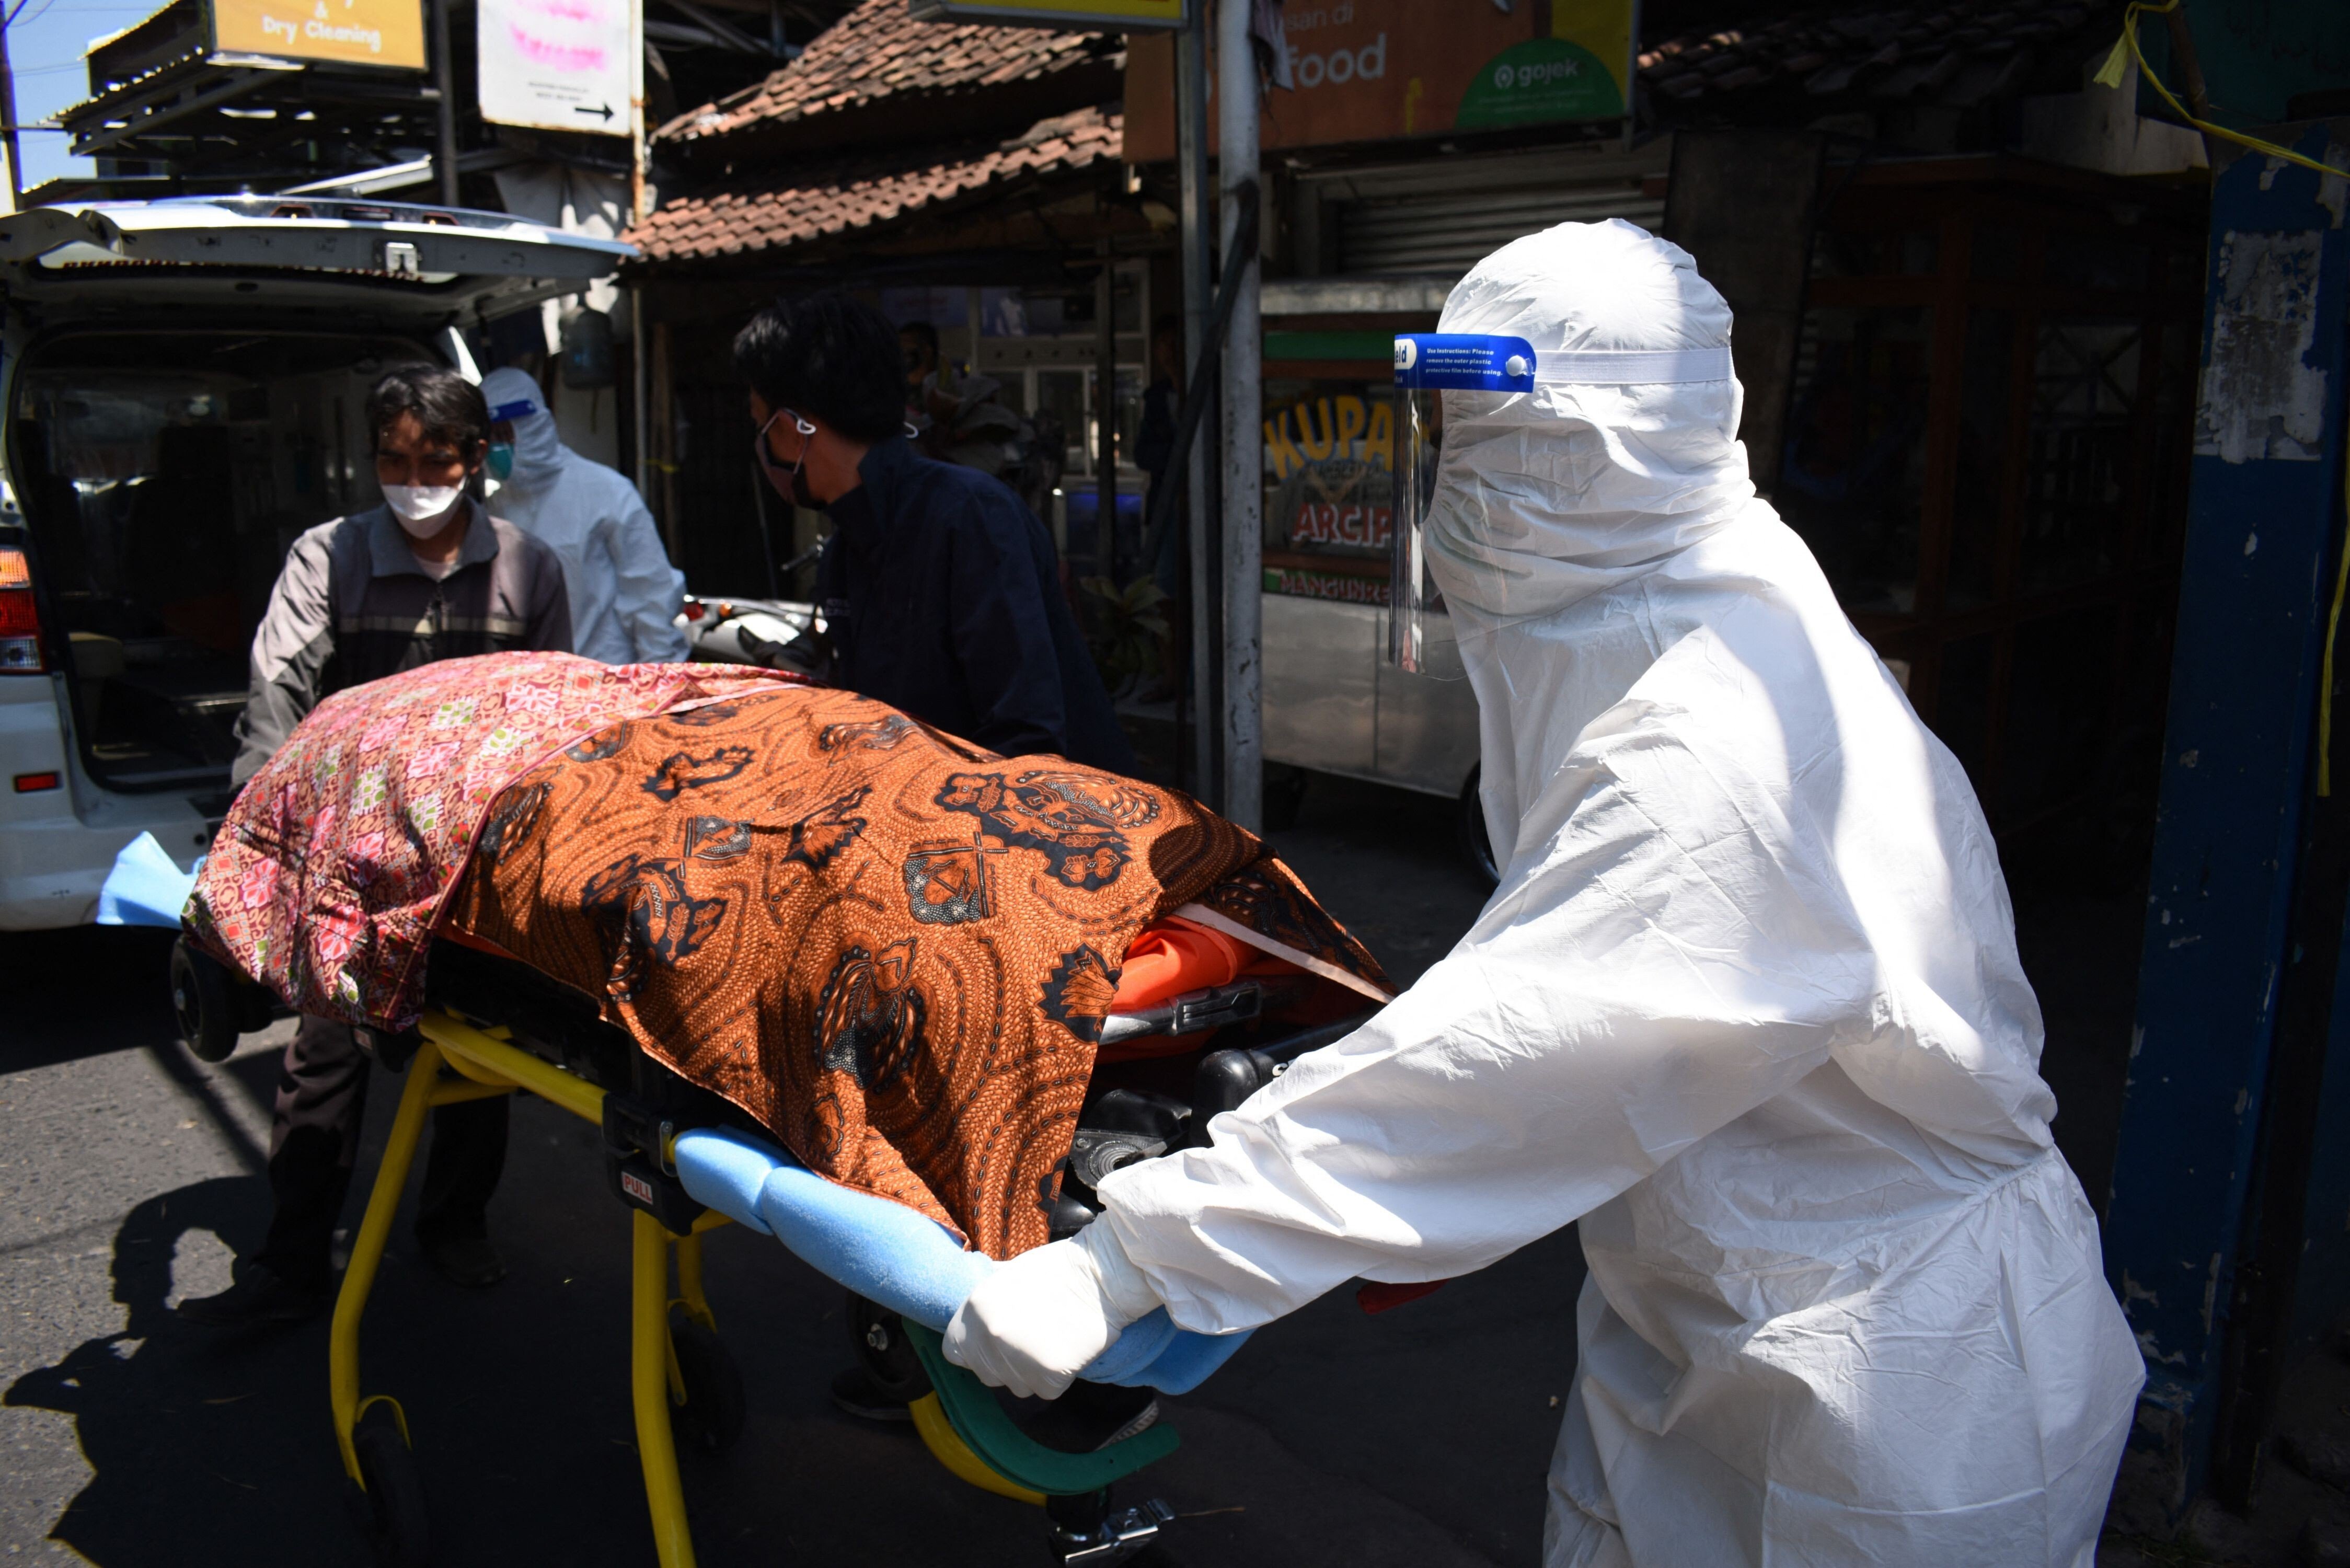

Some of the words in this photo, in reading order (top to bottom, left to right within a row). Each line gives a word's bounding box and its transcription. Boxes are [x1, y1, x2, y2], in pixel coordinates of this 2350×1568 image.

[315, 0, 328, 19] &
[262, 15, 297, 44] Dry
[305, 20, 382, 53] Cleaning
[1518, 58, 1578, 87] gojek
[1292, 502, 1392, 549] ARCIP
[1280, 570, 1390, 603] MANGUNRE
[625, 1175, 652, 1202] PULL
